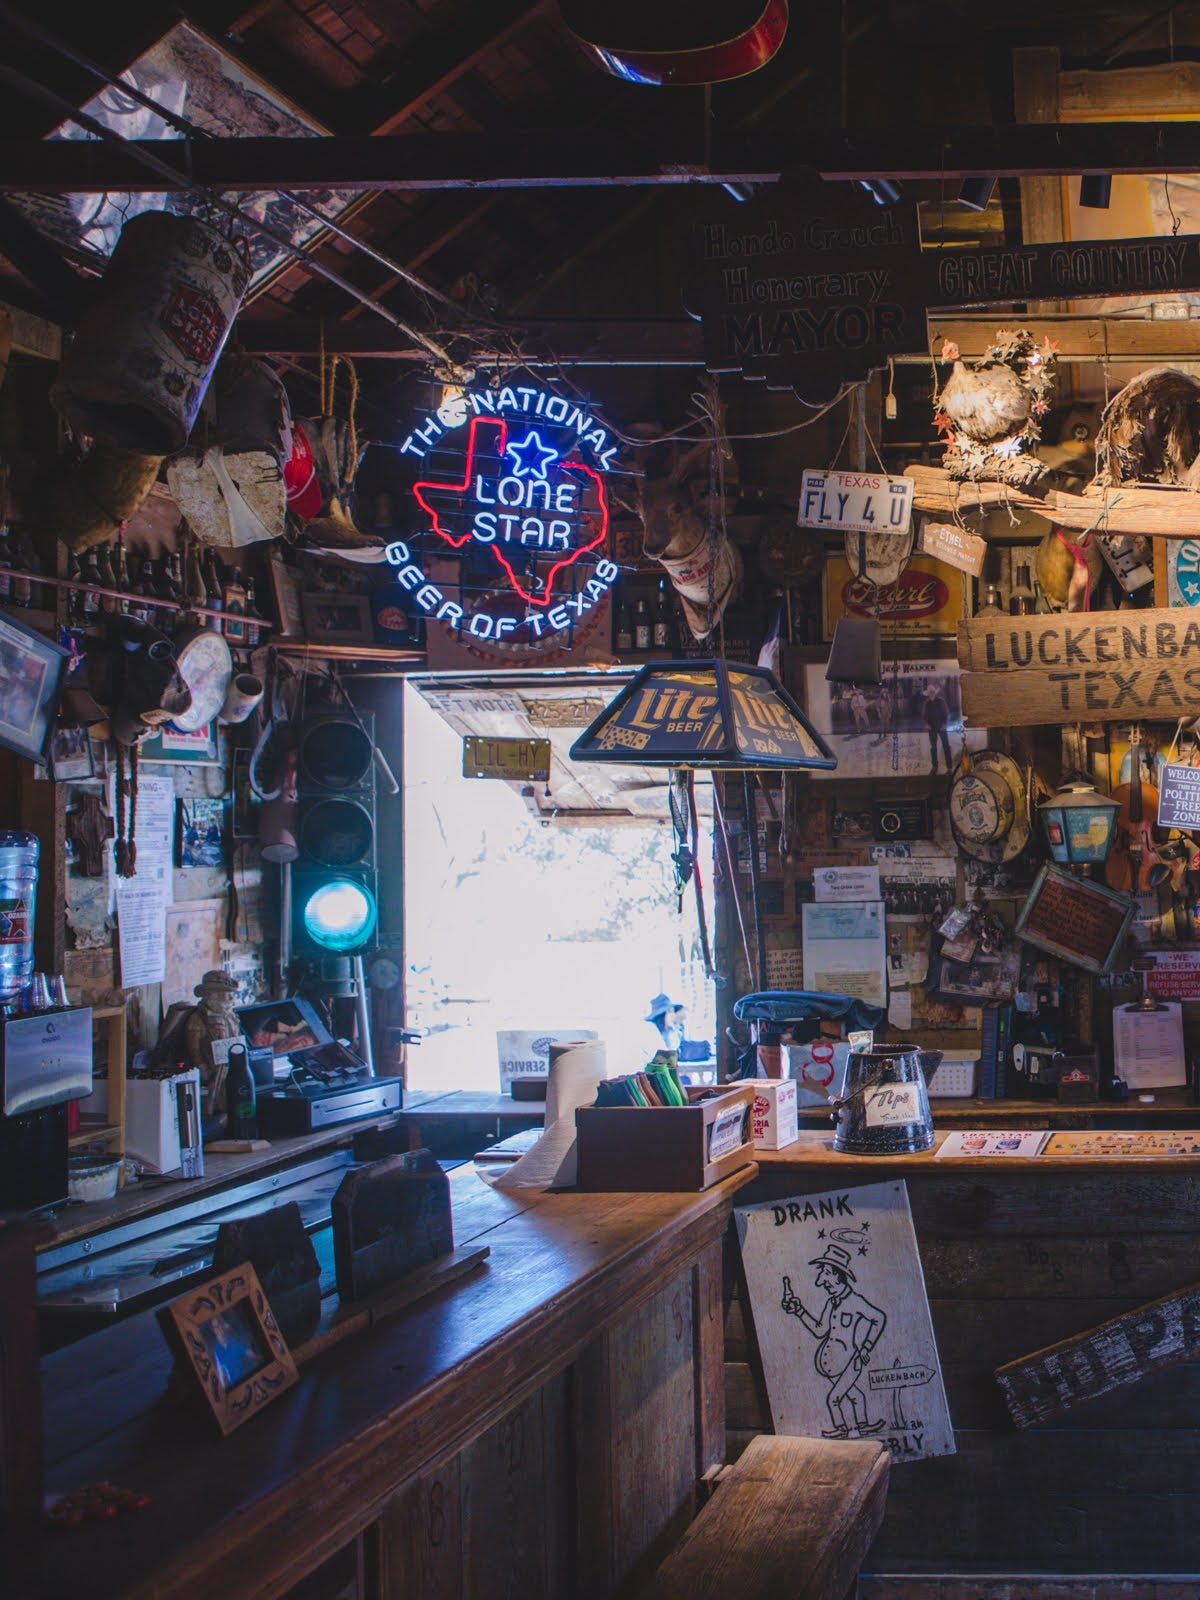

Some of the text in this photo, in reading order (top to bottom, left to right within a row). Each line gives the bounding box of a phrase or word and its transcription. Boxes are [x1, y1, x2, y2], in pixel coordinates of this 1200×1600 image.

[703, 209, 905, 260] Hondo Crouch
[722, 266, 888, 304] Honorary
[938, 252, 1037, 298] GREAT
[1050, 241, 1187, 288] COUNTRY
[725, 304, 905, 358] MAYOR
[469, 387, 617, 470] NATIONAL
[476, 475, 576, 512] LONE
[837, 475, 880, 489] TEXAS
[803, 491, 904, 525] FLY 4 U
[472, 512, 571, 549] STAR
[940, 528, 963, 549] ETHEL
[385, 541, 617, 639] BEER OF TEXAS
[848, 580, 937, 607] Pearl
[903, 664, 936, 674] WALKER
[630, 688, 720, 731] Lite
[731, 688, 791, 735] Lite
[666, 722, 703, 733] BEER
[774, 730, 798, 742] BEER
[474, 743, 539, 769] LIL-HY
[1175, 800, 1200, 812] FREE
[867, 1089, 909, 1109] Tips
[771, 1194, 854, 1227] DRANK
[871, 1370, 925, 1384] LUCKENBACH
